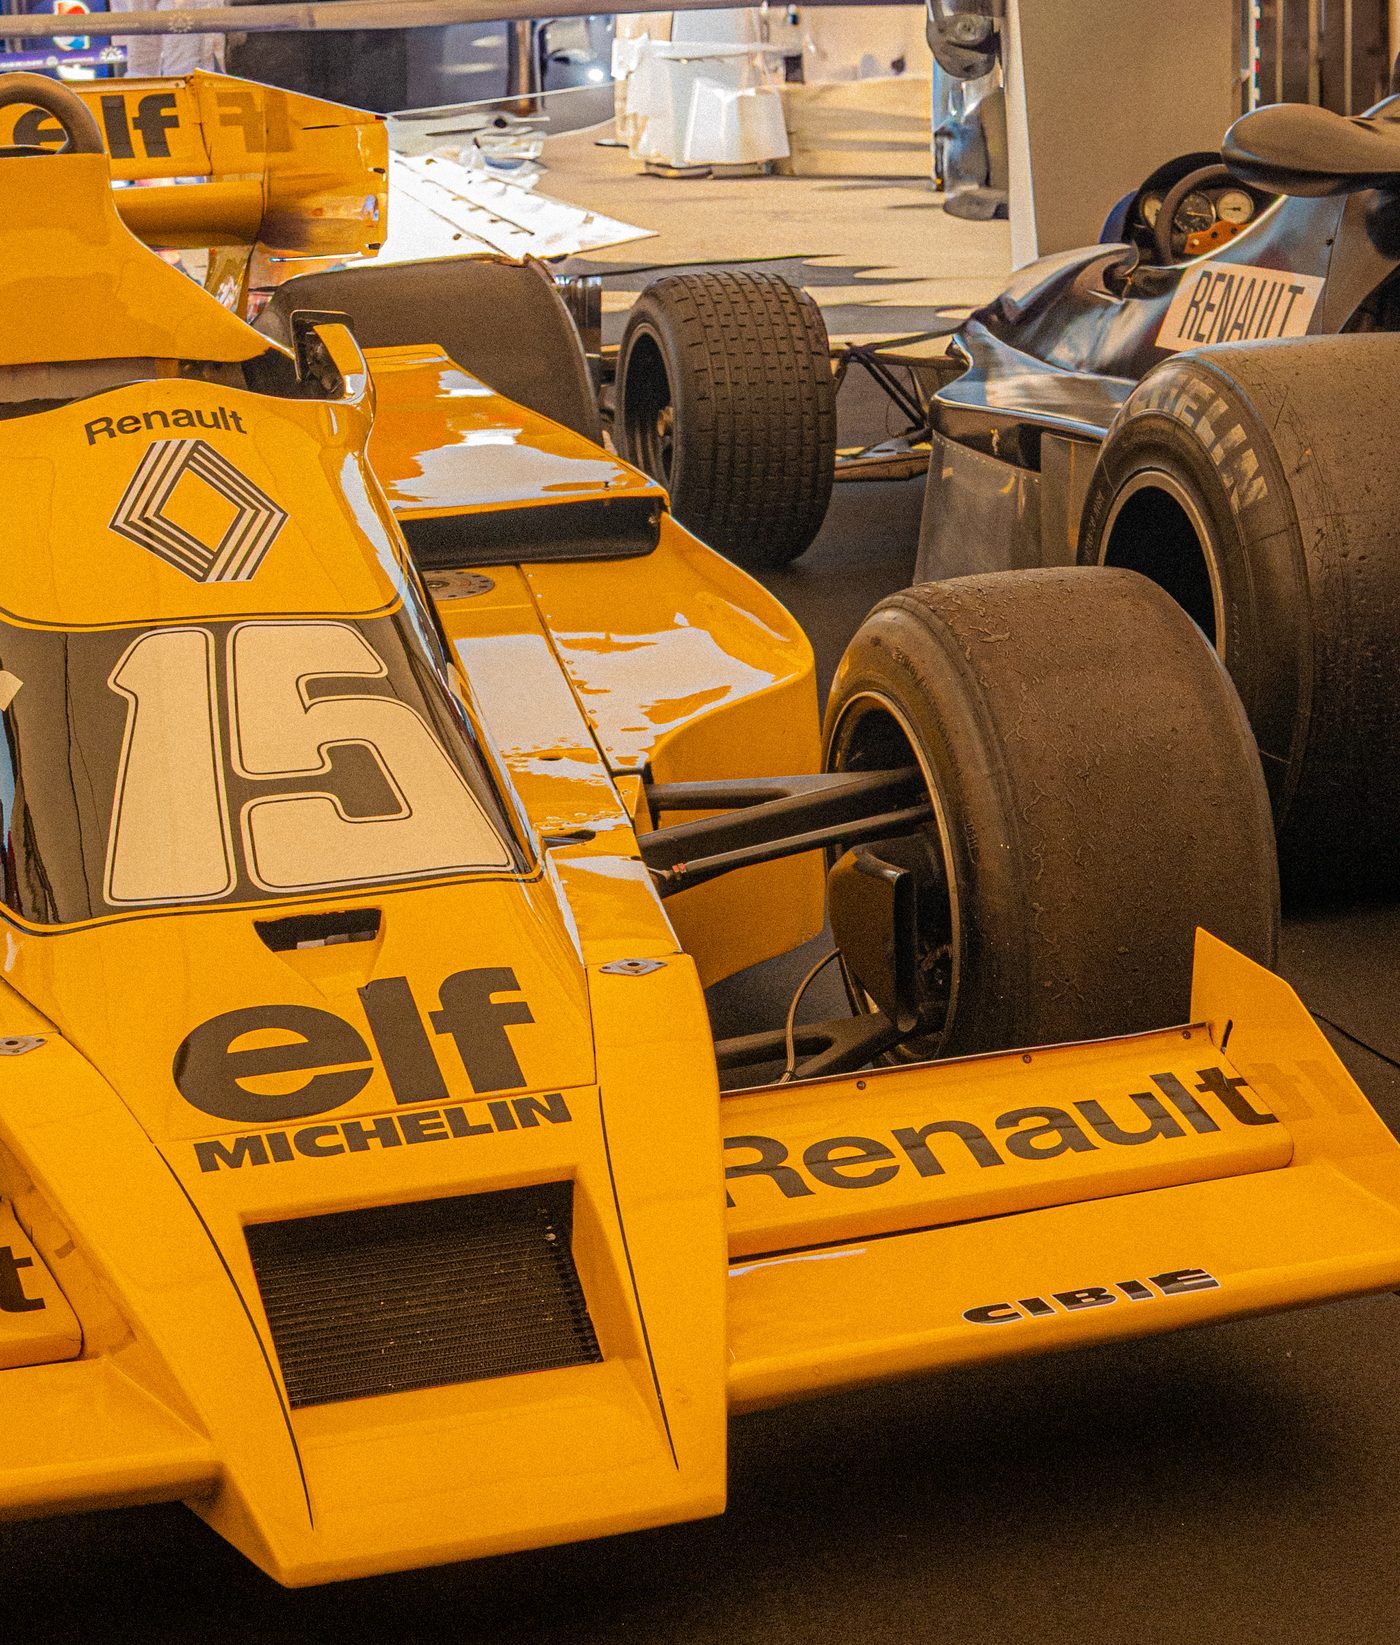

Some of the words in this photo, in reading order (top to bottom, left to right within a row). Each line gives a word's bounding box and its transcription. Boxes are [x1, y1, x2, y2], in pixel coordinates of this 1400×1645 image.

[1177, 270, 1305, 344] RENAULT
[84, 406, 247, 446] Renault
[103, 620, 516, 906] 15
[172, 966, 535, 1123] elf
[194, 1093, 571, 1172] MICHELIN
[724, 1066, 1278, 1208] Renault
